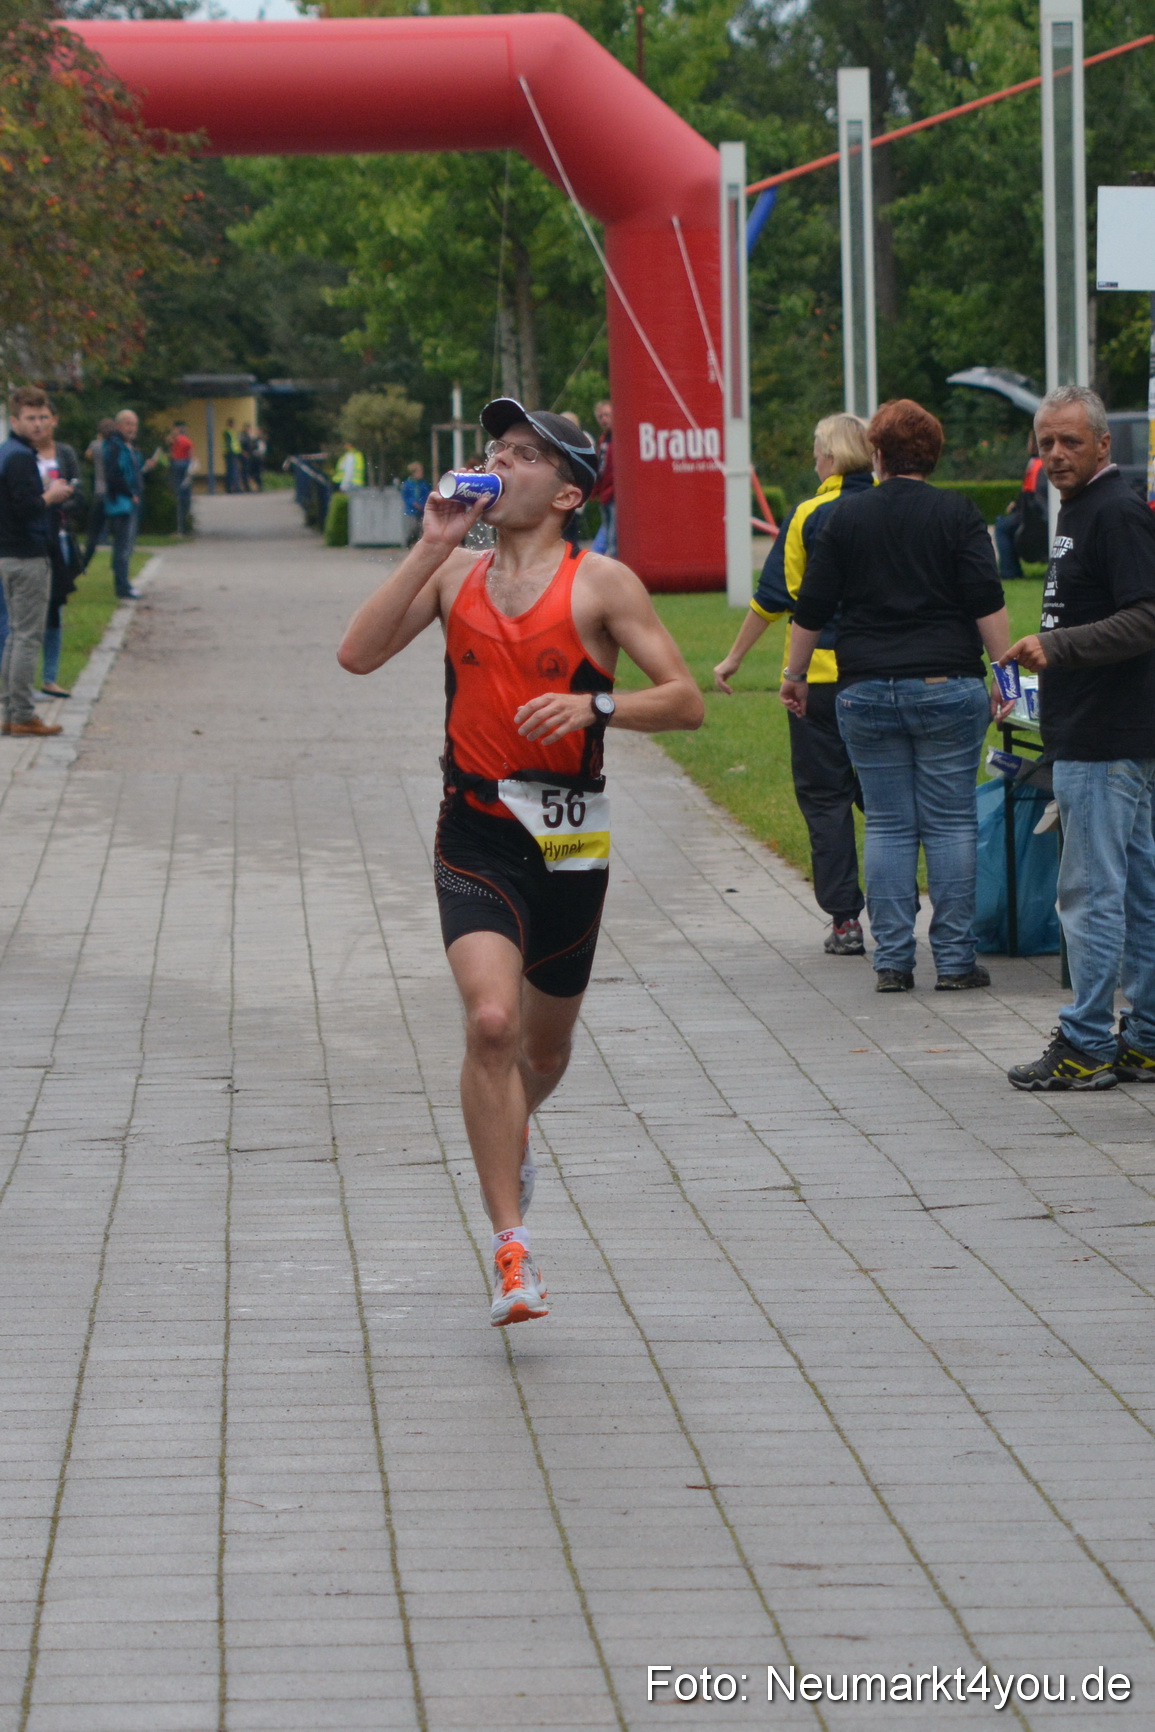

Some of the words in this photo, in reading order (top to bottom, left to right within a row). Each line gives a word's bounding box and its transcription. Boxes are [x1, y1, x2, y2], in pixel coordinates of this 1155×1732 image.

[639, 422, 720, 461] Braun
[541, 789, 586, 828] 56
[543, 840, 584, 861] Hynek
